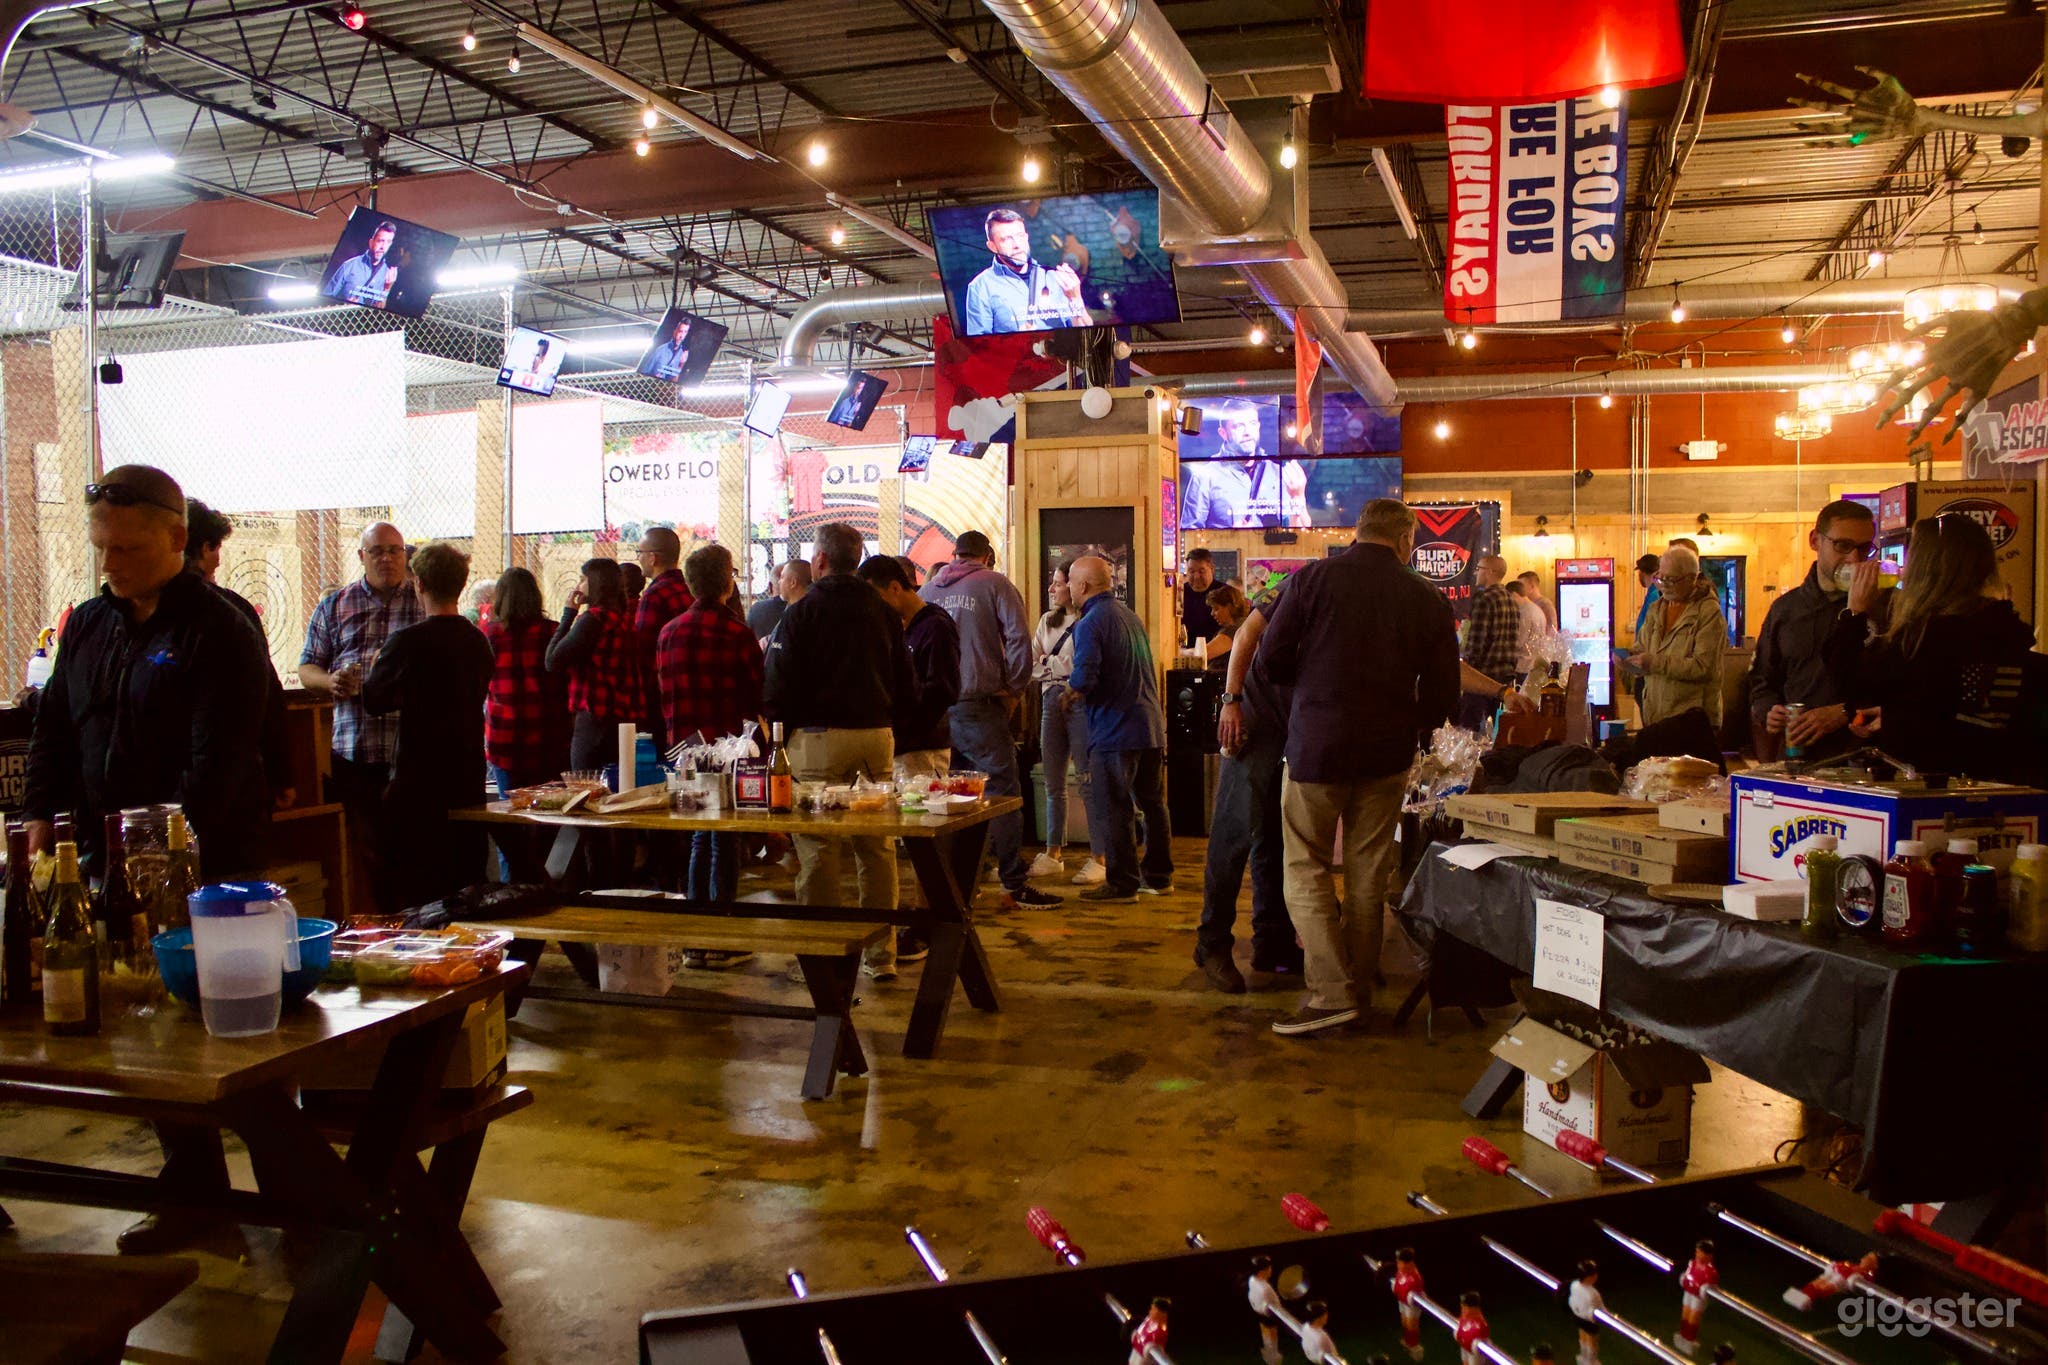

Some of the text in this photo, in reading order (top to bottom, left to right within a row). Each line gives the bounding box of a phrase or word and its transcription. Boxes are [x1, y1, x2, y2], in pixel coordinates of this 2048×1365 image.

[1999, 426, 2048, 451] ESCA
[604, 460, 719, 483] OWERS FLO
[1416, 549, 1456, 561] BURY
[1420, 560, 1461, 573] HATCHET
[1459, 584, 1471, 598] NJ
[1770, 816, 1847, 858] SABRETT
[1974, 833, 2024, 852] RETT
[1538, 1101, 1578, 1130] Handmade
